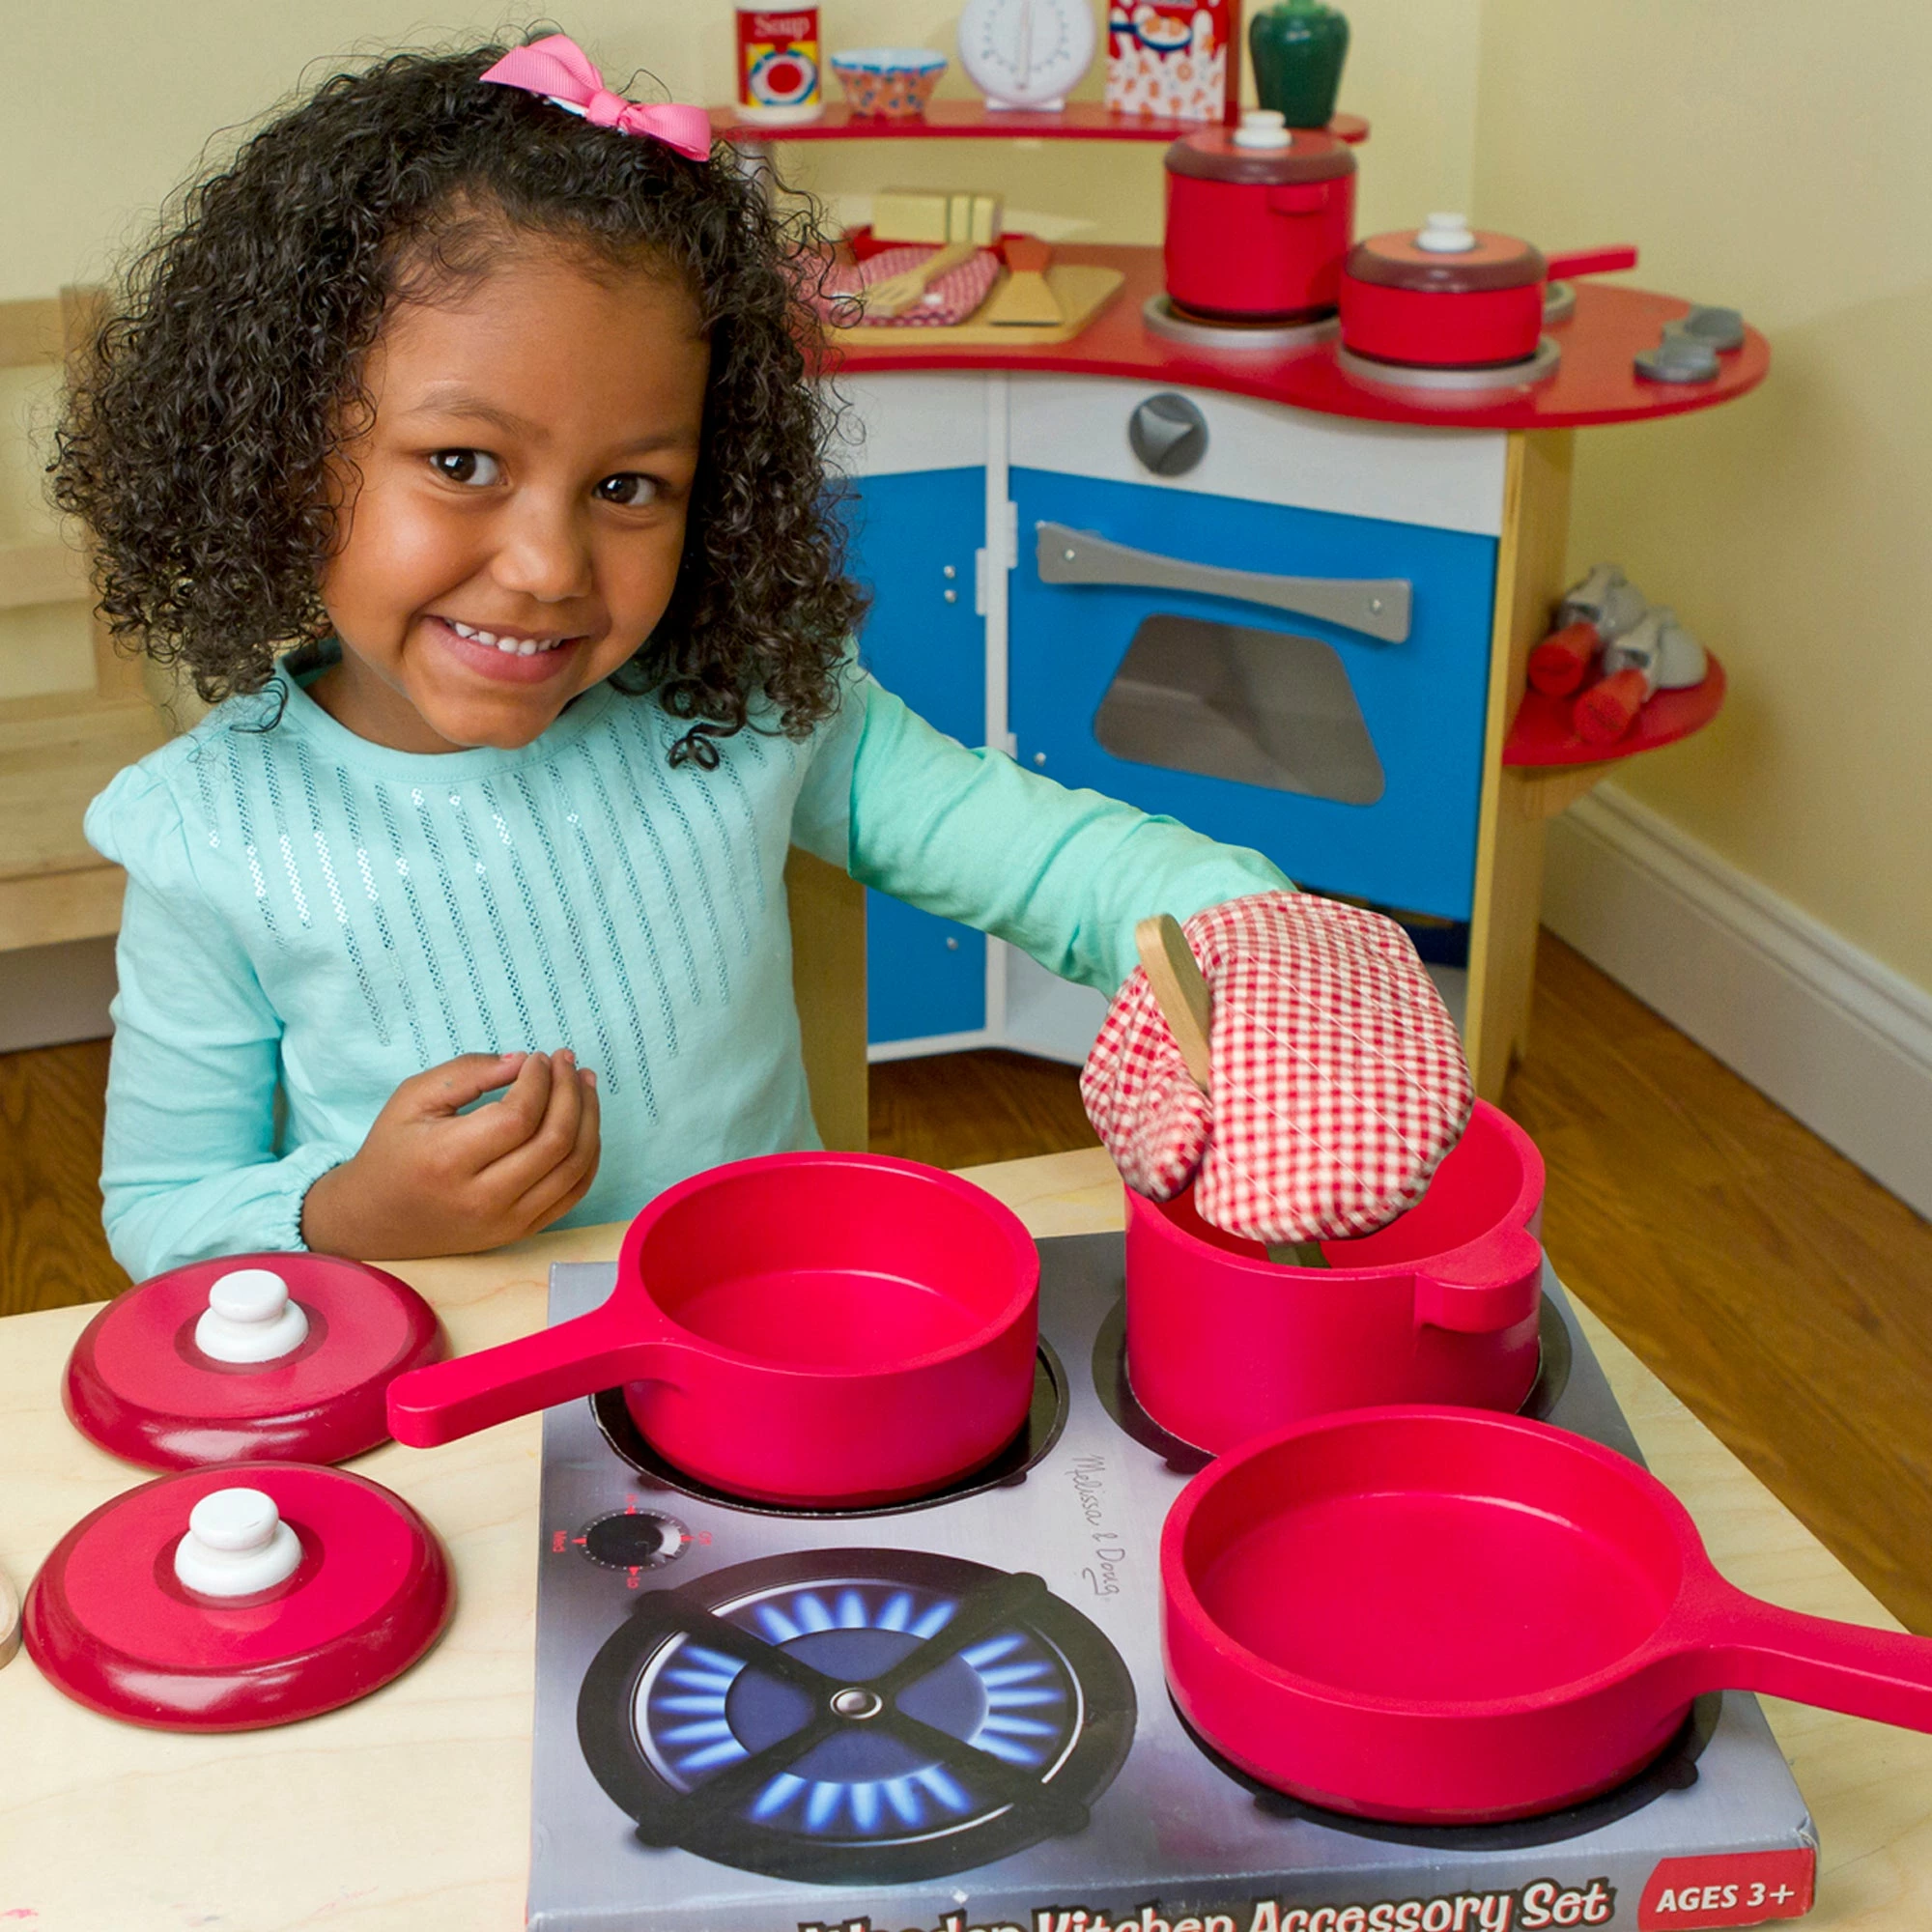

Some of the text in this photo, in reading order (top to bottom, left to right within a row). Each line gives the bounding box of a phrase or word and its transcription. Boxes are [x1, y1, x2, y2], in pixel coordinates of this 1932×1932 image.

[754, 14, 811, 41] Soup
[1064, 1453, 1106, 1526] Melissa
[1082, 1548, 1126, 1598] Doug
[1247, 1889, 1516, 1932] Accessory
[1520, 1881, 1612, 1927] Set
[1655, 1882, 1797, 1914] AGES 3+
